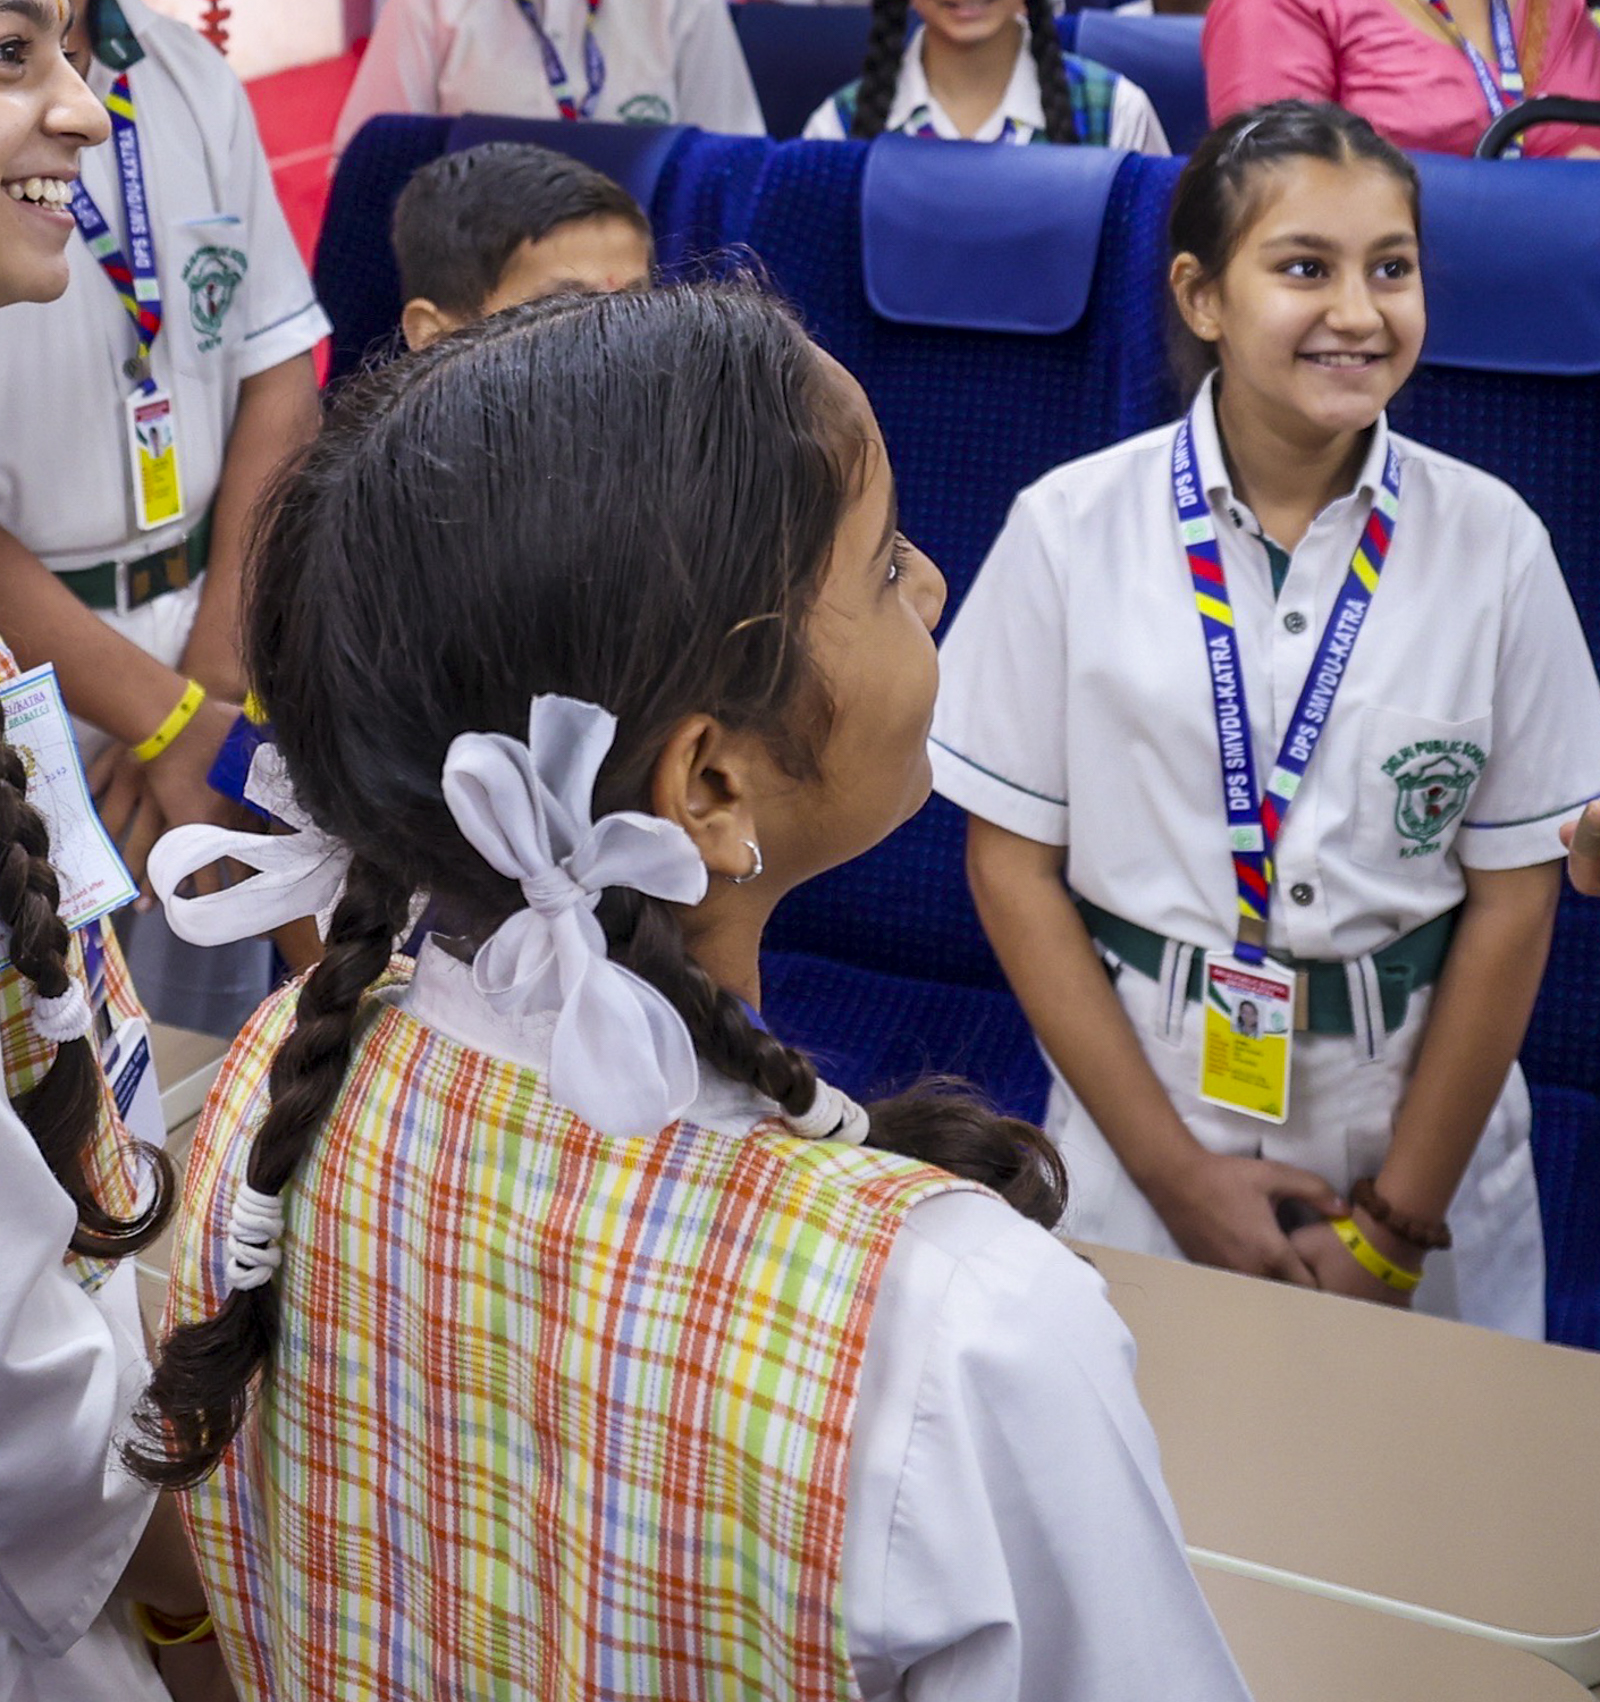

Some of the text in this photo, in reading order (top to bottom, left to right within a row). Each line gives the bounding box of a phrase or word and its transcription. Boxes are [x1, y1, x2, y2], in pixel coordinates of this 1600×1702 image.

[1175, 472, 1198, 508] DPS
[1209, 635, 1251, 811] DPS SMVDU-KATRA
[1289, 598, 1367, 762] DPS SMVDU-KATRA
[1415, 740, 1462, 758] PUBLIC
